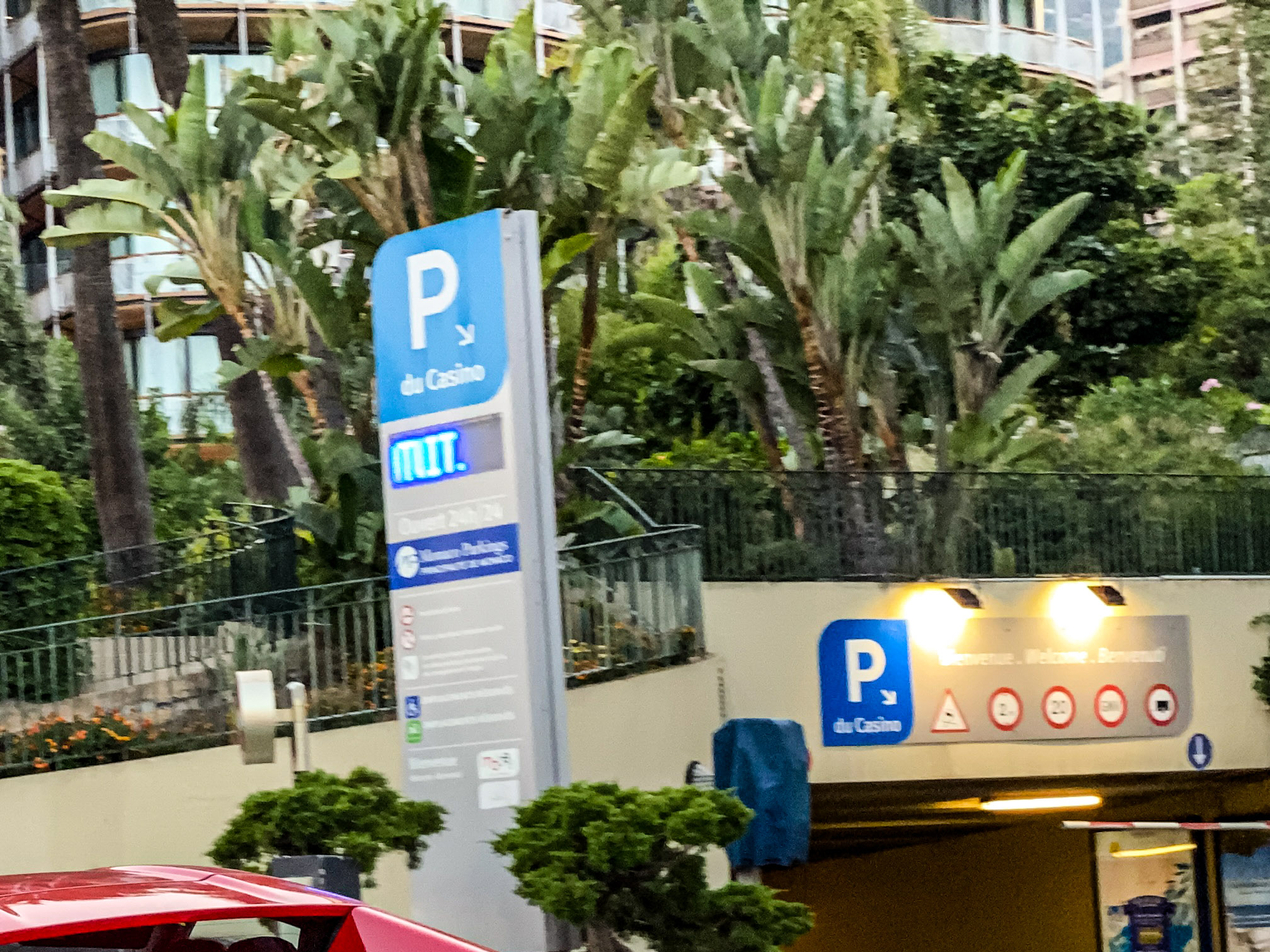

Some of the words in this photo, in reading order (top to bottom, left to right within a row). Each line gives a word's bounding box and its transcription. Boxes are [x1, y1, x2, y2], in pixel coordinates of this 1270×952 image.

[406, 249, 459, 350] P
[400, 373, 424, 396] du
[425, 363, 486, 390] Casino
[845, 638, 887, 702] P
[833, 717, 854, 734] du
[854, 716, 902, 733] Casino
